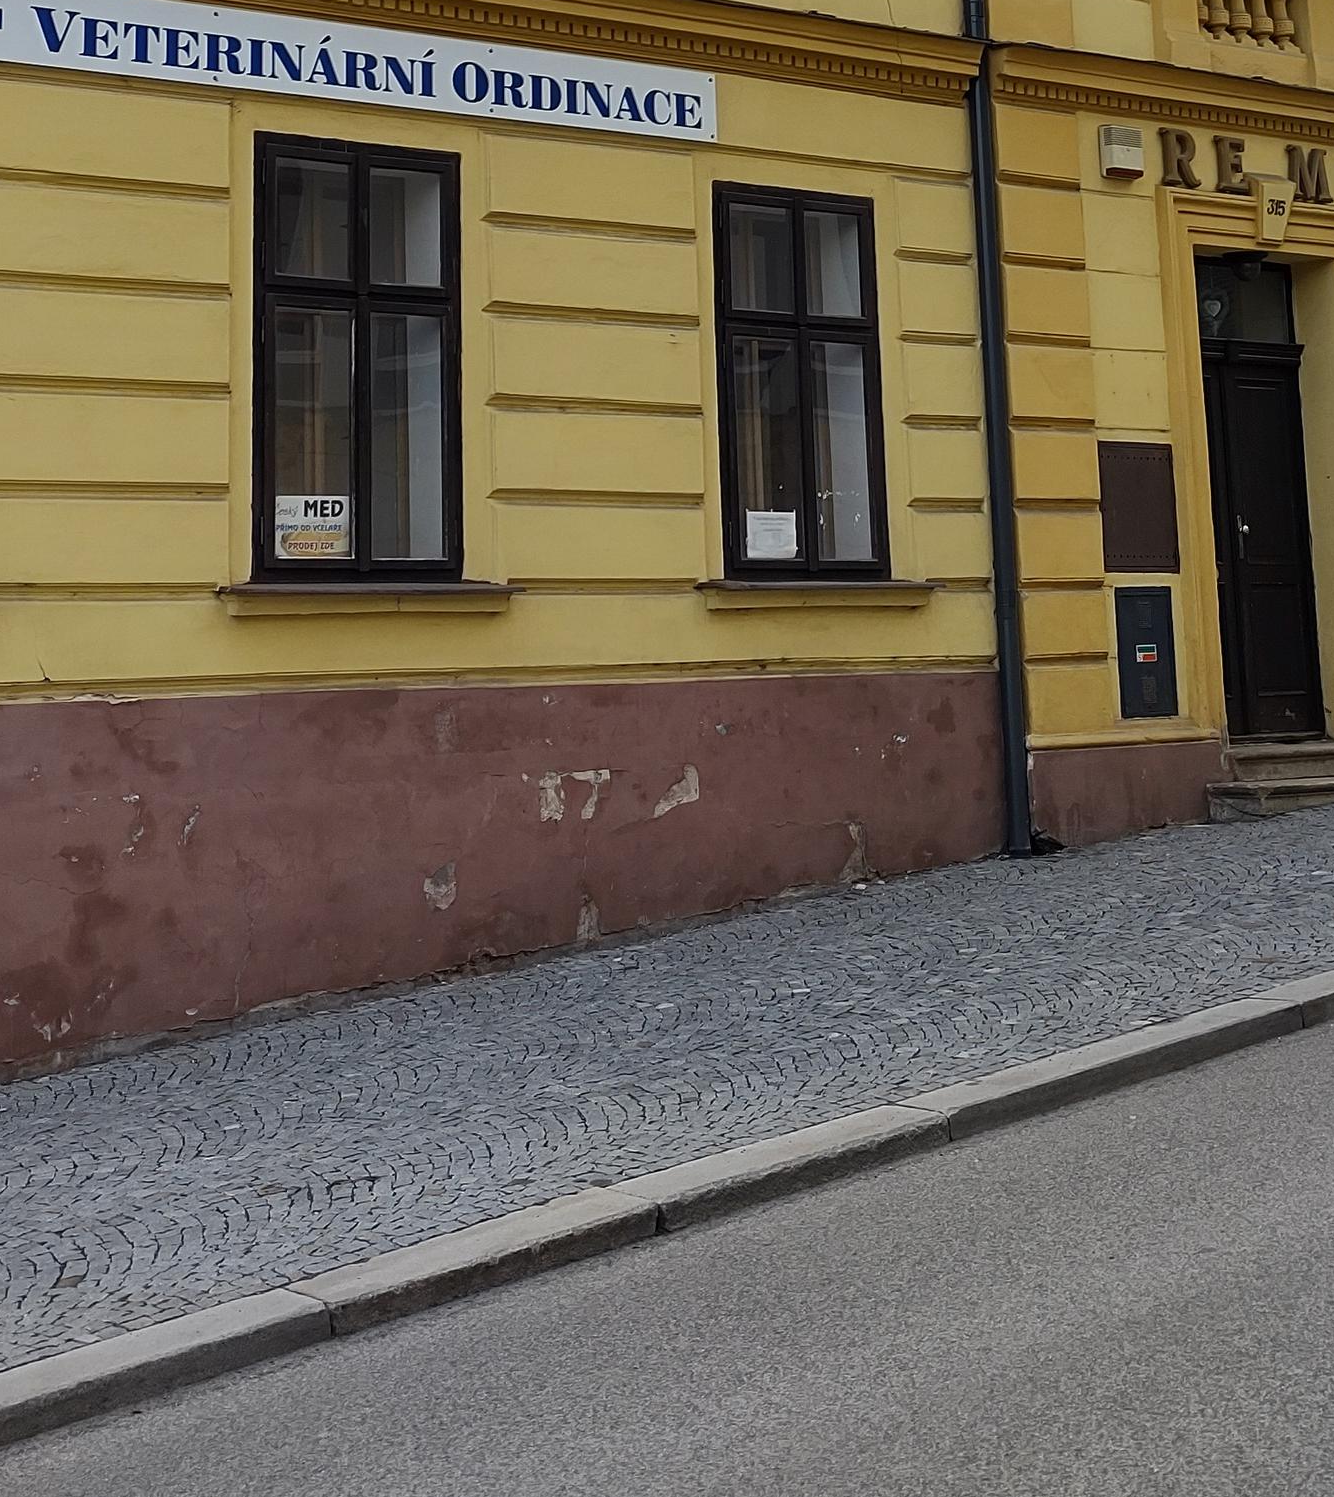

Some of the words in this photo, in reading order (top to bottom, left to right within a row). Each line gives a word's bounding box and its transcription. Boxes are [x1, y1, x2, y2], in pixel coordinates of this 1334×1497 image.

[29, 5, 437, 98] VETERINÁRNÍ
[452, 61, 703, 129] ORDINACE
[1267, 199, 1286, 216] 315
[303, 499, 344, 518] MED
[300, 524, 312, 532] OD
[288, 542, 318, 551] PRODEJ
[320, 542, 335, 550] ZDE
